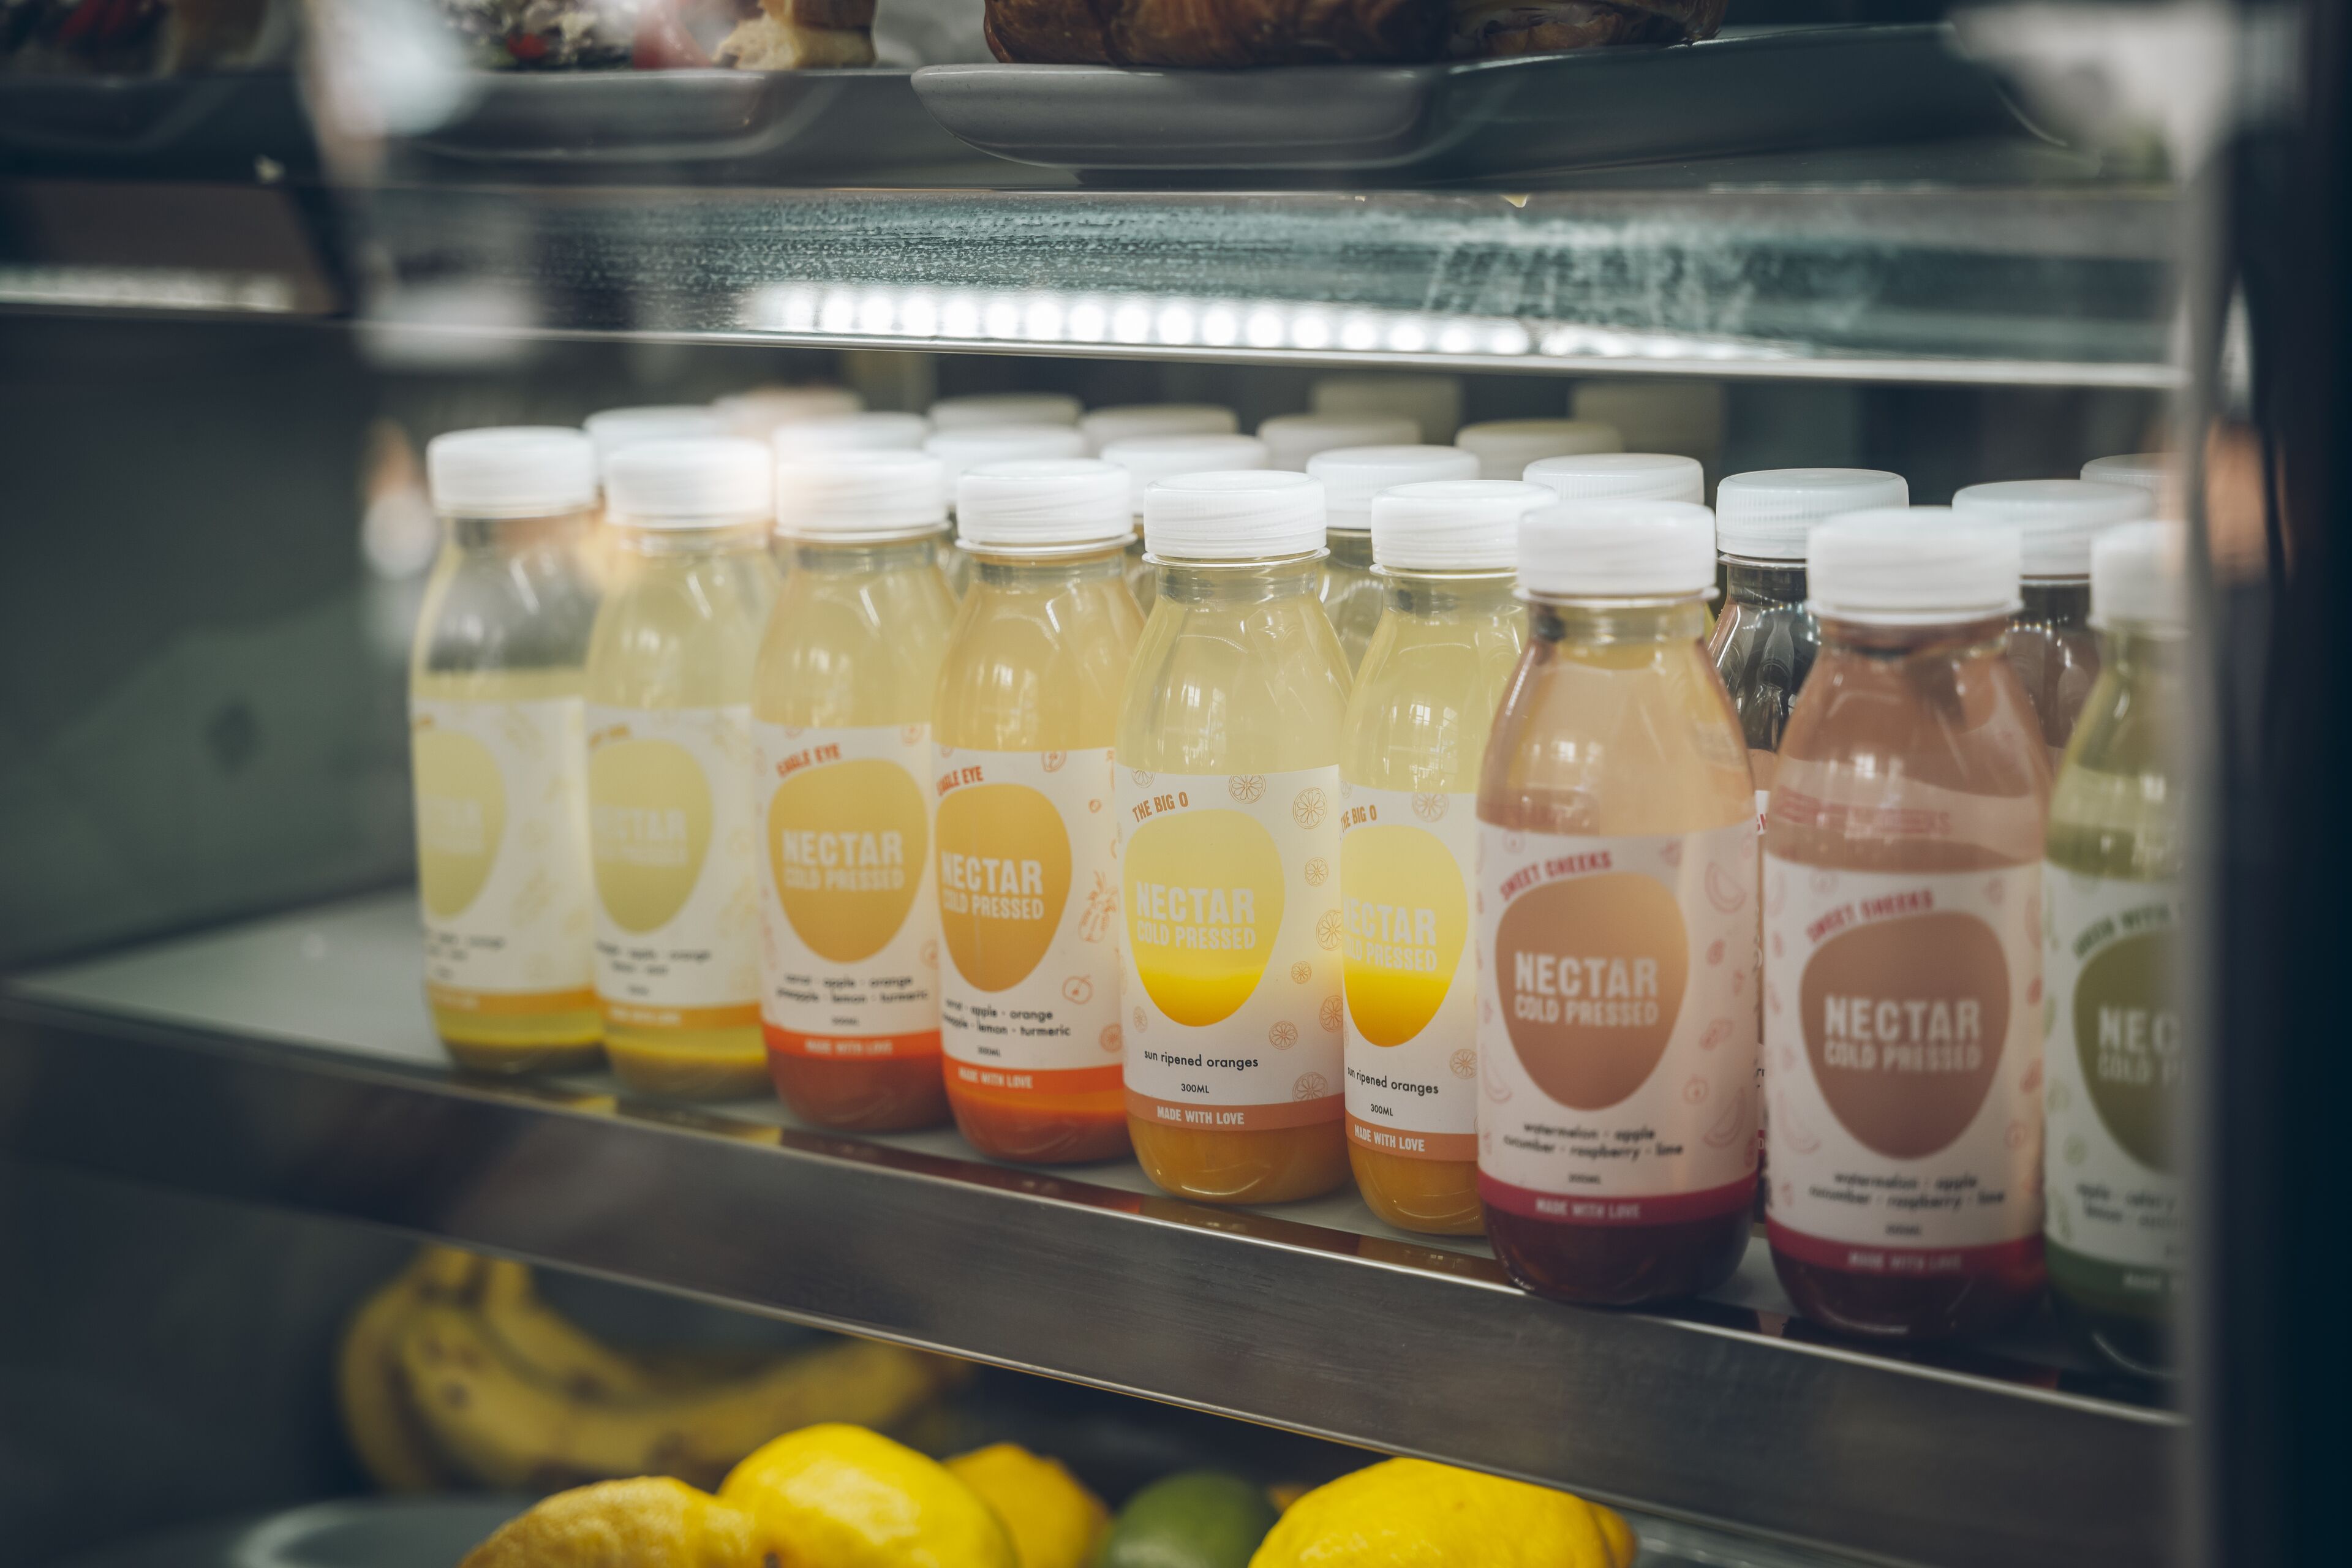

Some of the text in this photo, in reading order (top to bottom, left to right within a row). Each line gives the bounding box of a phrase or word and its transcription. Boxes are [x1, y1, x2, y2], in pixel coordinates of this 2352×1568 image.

[962, 766, 984, 784] EYE
[1133, 791, 1189, 823] THE BIG O
[1352, 806, 1367, 824] BIG
[1369, 804, 1378, 821] O
[783, 830, 903, 867] NECTAR
[825, 867, 905, 892] PRESSED
[941, 850, 1043, 895] NECTAR
[1500, 851, 1612, 902] SWEET CHEEKS
[971, 893, 1045, 921] PRESSED
[1136, 881, 1256, 925] NECTAR
[1343, 893, 1437, 946] NECTAR
[1137, 919, 1257, 951] COLD PRESSED
[1366, 941, 1438, 971] PRESSED
[1514, 950, 1658, 998] NECTAR
[970, 1003, 998, 1019] apple
[1009, 1010, 1054, 1023] orange
[1514, 993, 1660, 1028] COLD PRESSED
[1824, 993, 1983, 1042] NECTAR
[976, 1016, 1008, 1035] lemon
[1020, 1023, 1071, 1036] turmeric
[2097, 1003, 2182, 1059] NEC
[1144, 1050, 1259, 1071] sun ripened oranges
[1824, 1039, 1985, 1073] COLD PRESSED
[957, 1068, 1033, 1088] MADE WITH LOVE
[1181, 1083, 1210, 1093] 300ML
[1357, 1069, 1387, 1085] ripened
[1391, 1081, 1439, 1096] oranges
[1157, 1105, 1245, 1125] MADE WITH LOVE
[1371, 1104, 1393, 1117] 300ML
[1354, 1124, 1425, 1152] MADE WITH LOVE
[1523, 1123, 1656, 1144] watermelon apple
[1569, 1142, 1641, 1162] raspberry
[1535, 1198, 1640, 1219] MADE WITH LOVE
